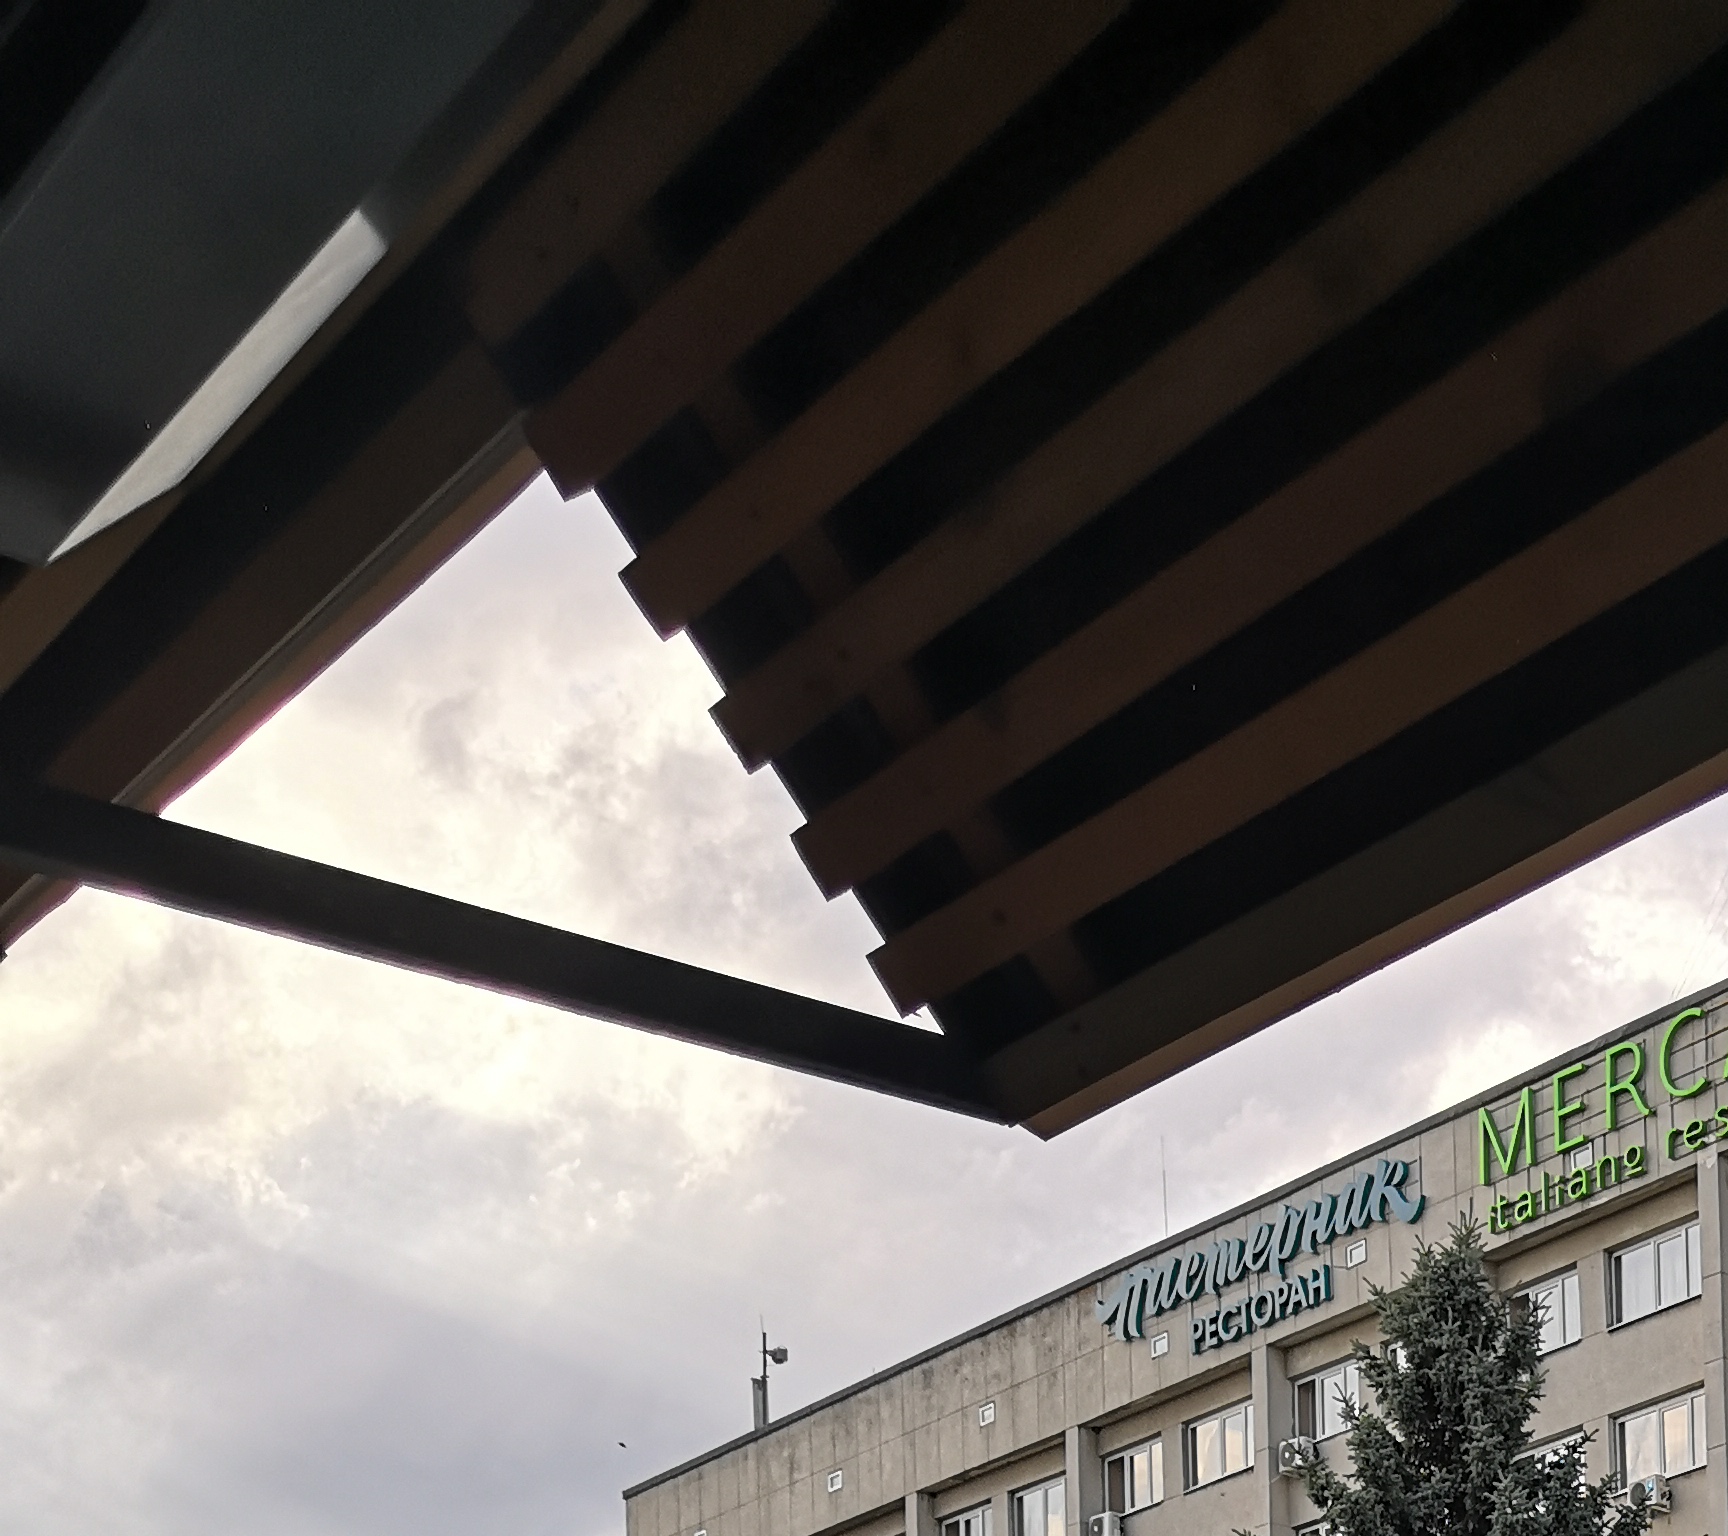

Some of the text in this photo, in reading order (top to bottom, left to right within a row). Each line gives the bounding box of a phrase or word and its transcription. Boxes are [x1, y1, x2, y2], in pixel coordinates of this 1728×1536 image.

[1488, 1144, 1648, 1234] italiano
[1096, 1158, 1426, 1342] Пастернак
[1192, 1264, 1331, 1355] РЕСТОРАН
